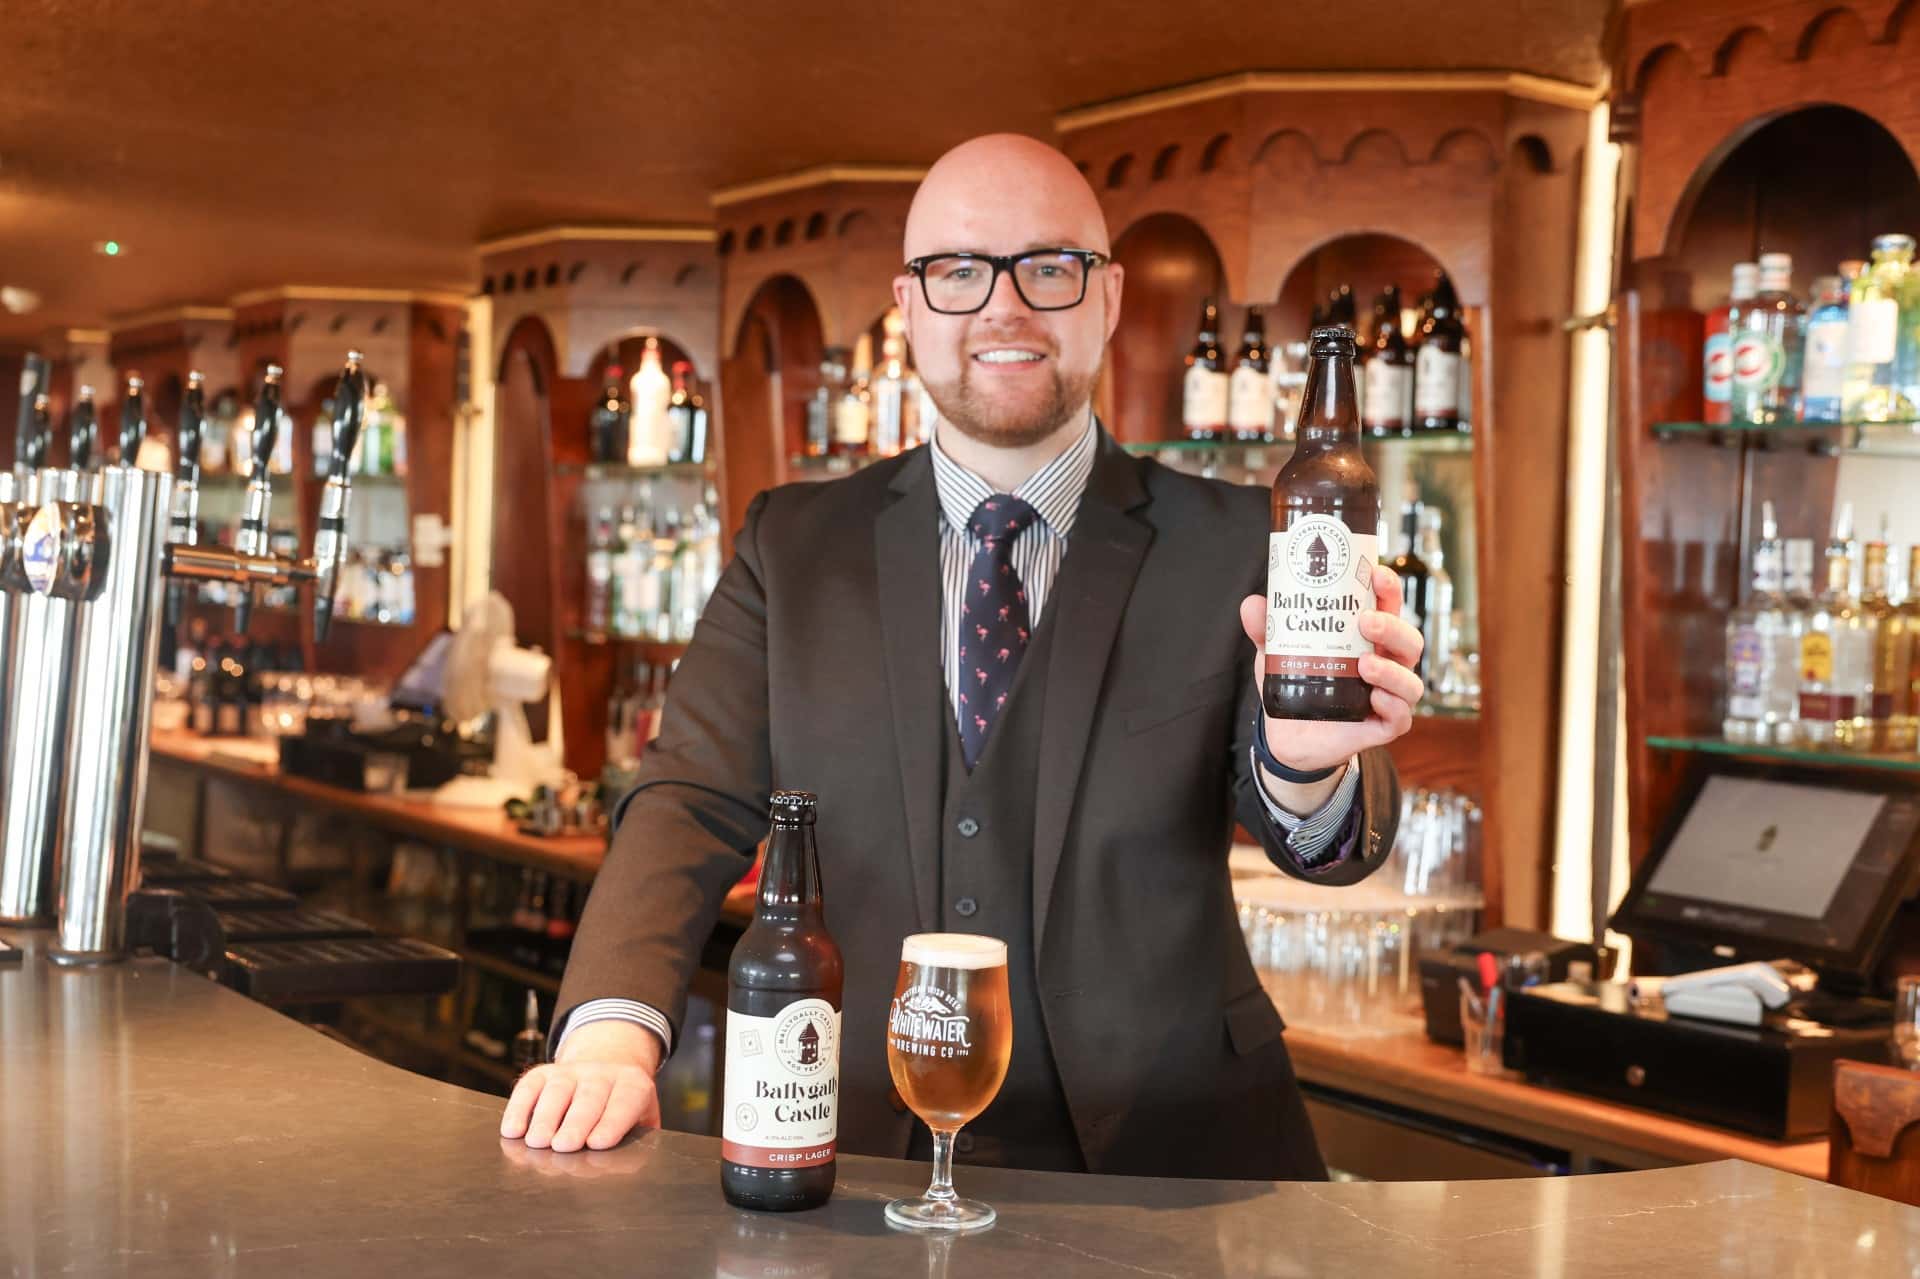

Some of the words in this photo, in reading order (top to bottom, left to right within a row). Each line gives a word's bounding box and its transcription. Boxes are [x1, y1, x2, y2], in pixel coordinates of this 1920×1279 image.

[1274, 592, 1360, 615] Ballygally
[1286, 614, 1345, 632] Castle
[1281, 661, 1309, 669] CRISP
[1313, 662, 1347, 671] LAGER
[890, 998, 971, 1047] WHITEWATER
[897, 1038, 936, 1057] BREWING
[775, 1102, 830, 1123] Castle
[769, 1153, 803, 1162] CRISP
